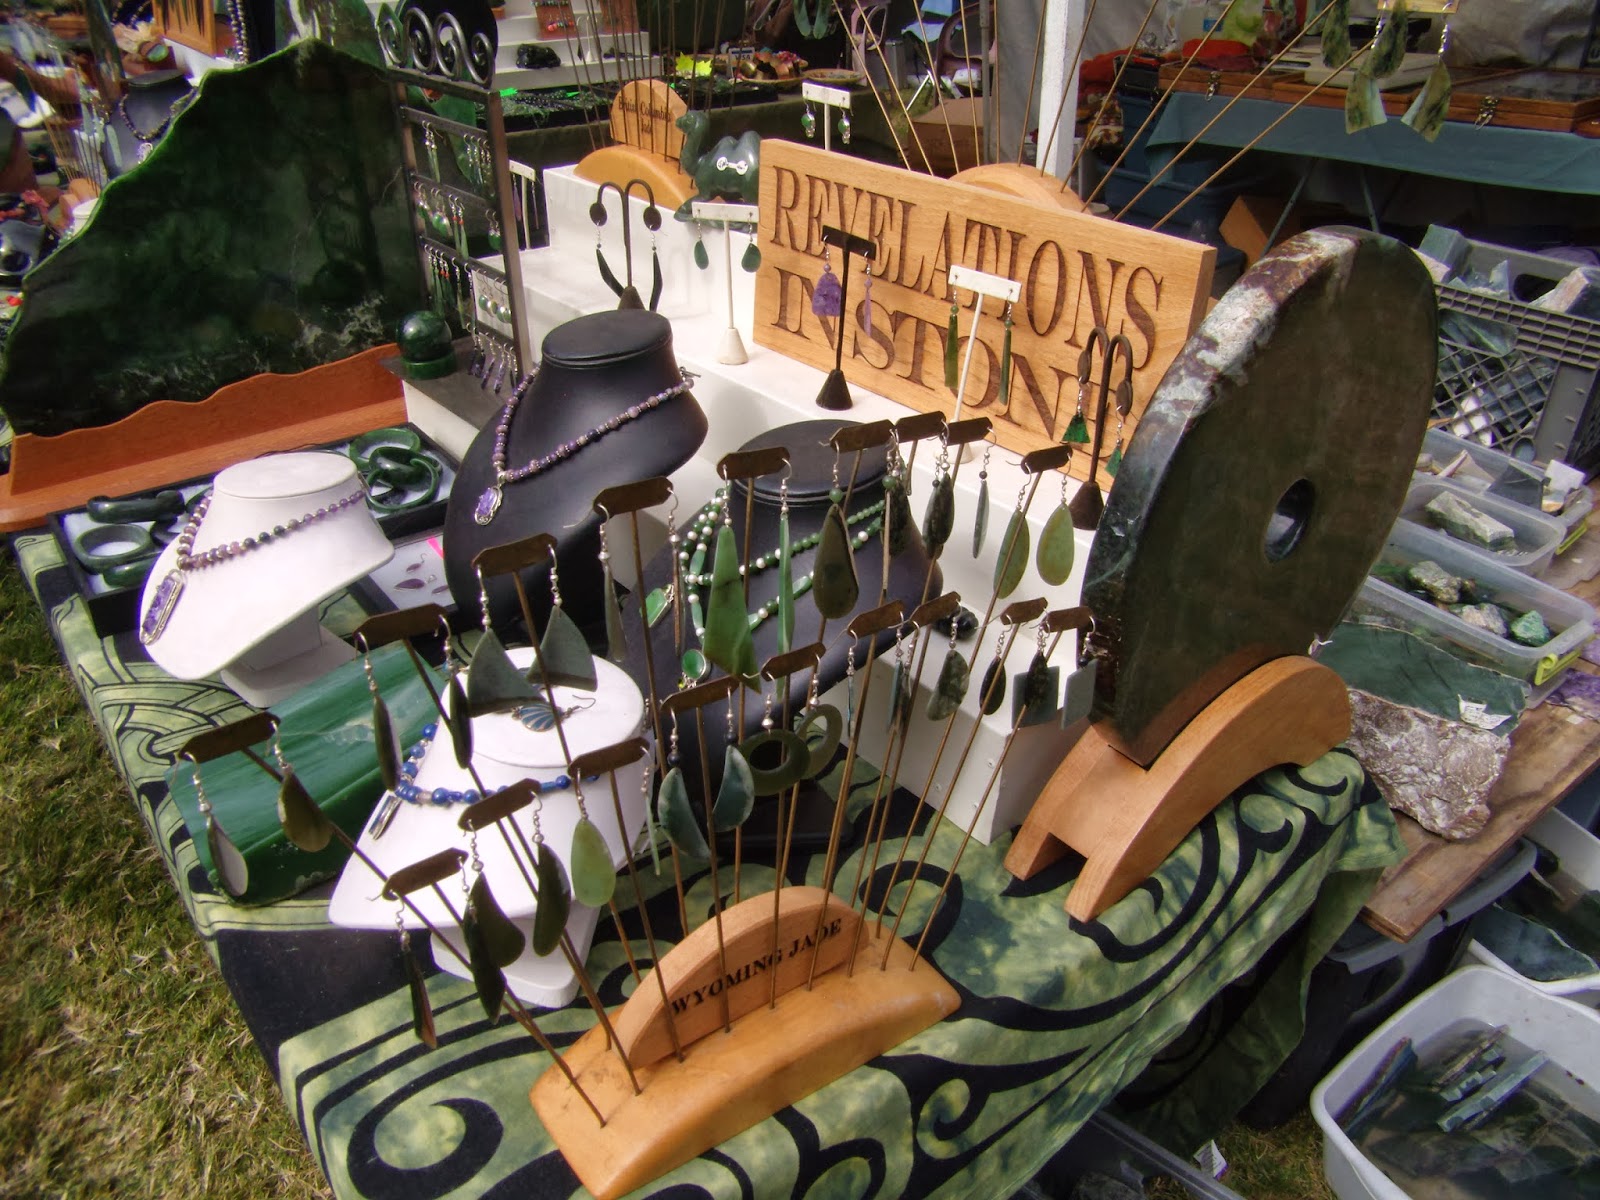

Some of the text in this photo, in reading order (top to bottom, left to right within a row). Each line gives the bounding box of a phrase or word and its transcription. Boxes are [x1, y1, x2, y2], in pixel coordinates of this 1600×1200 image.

[770, 165, 1165, 372] REVELATIONS
[671, 918, 842, 1015] WYOMING JADE
